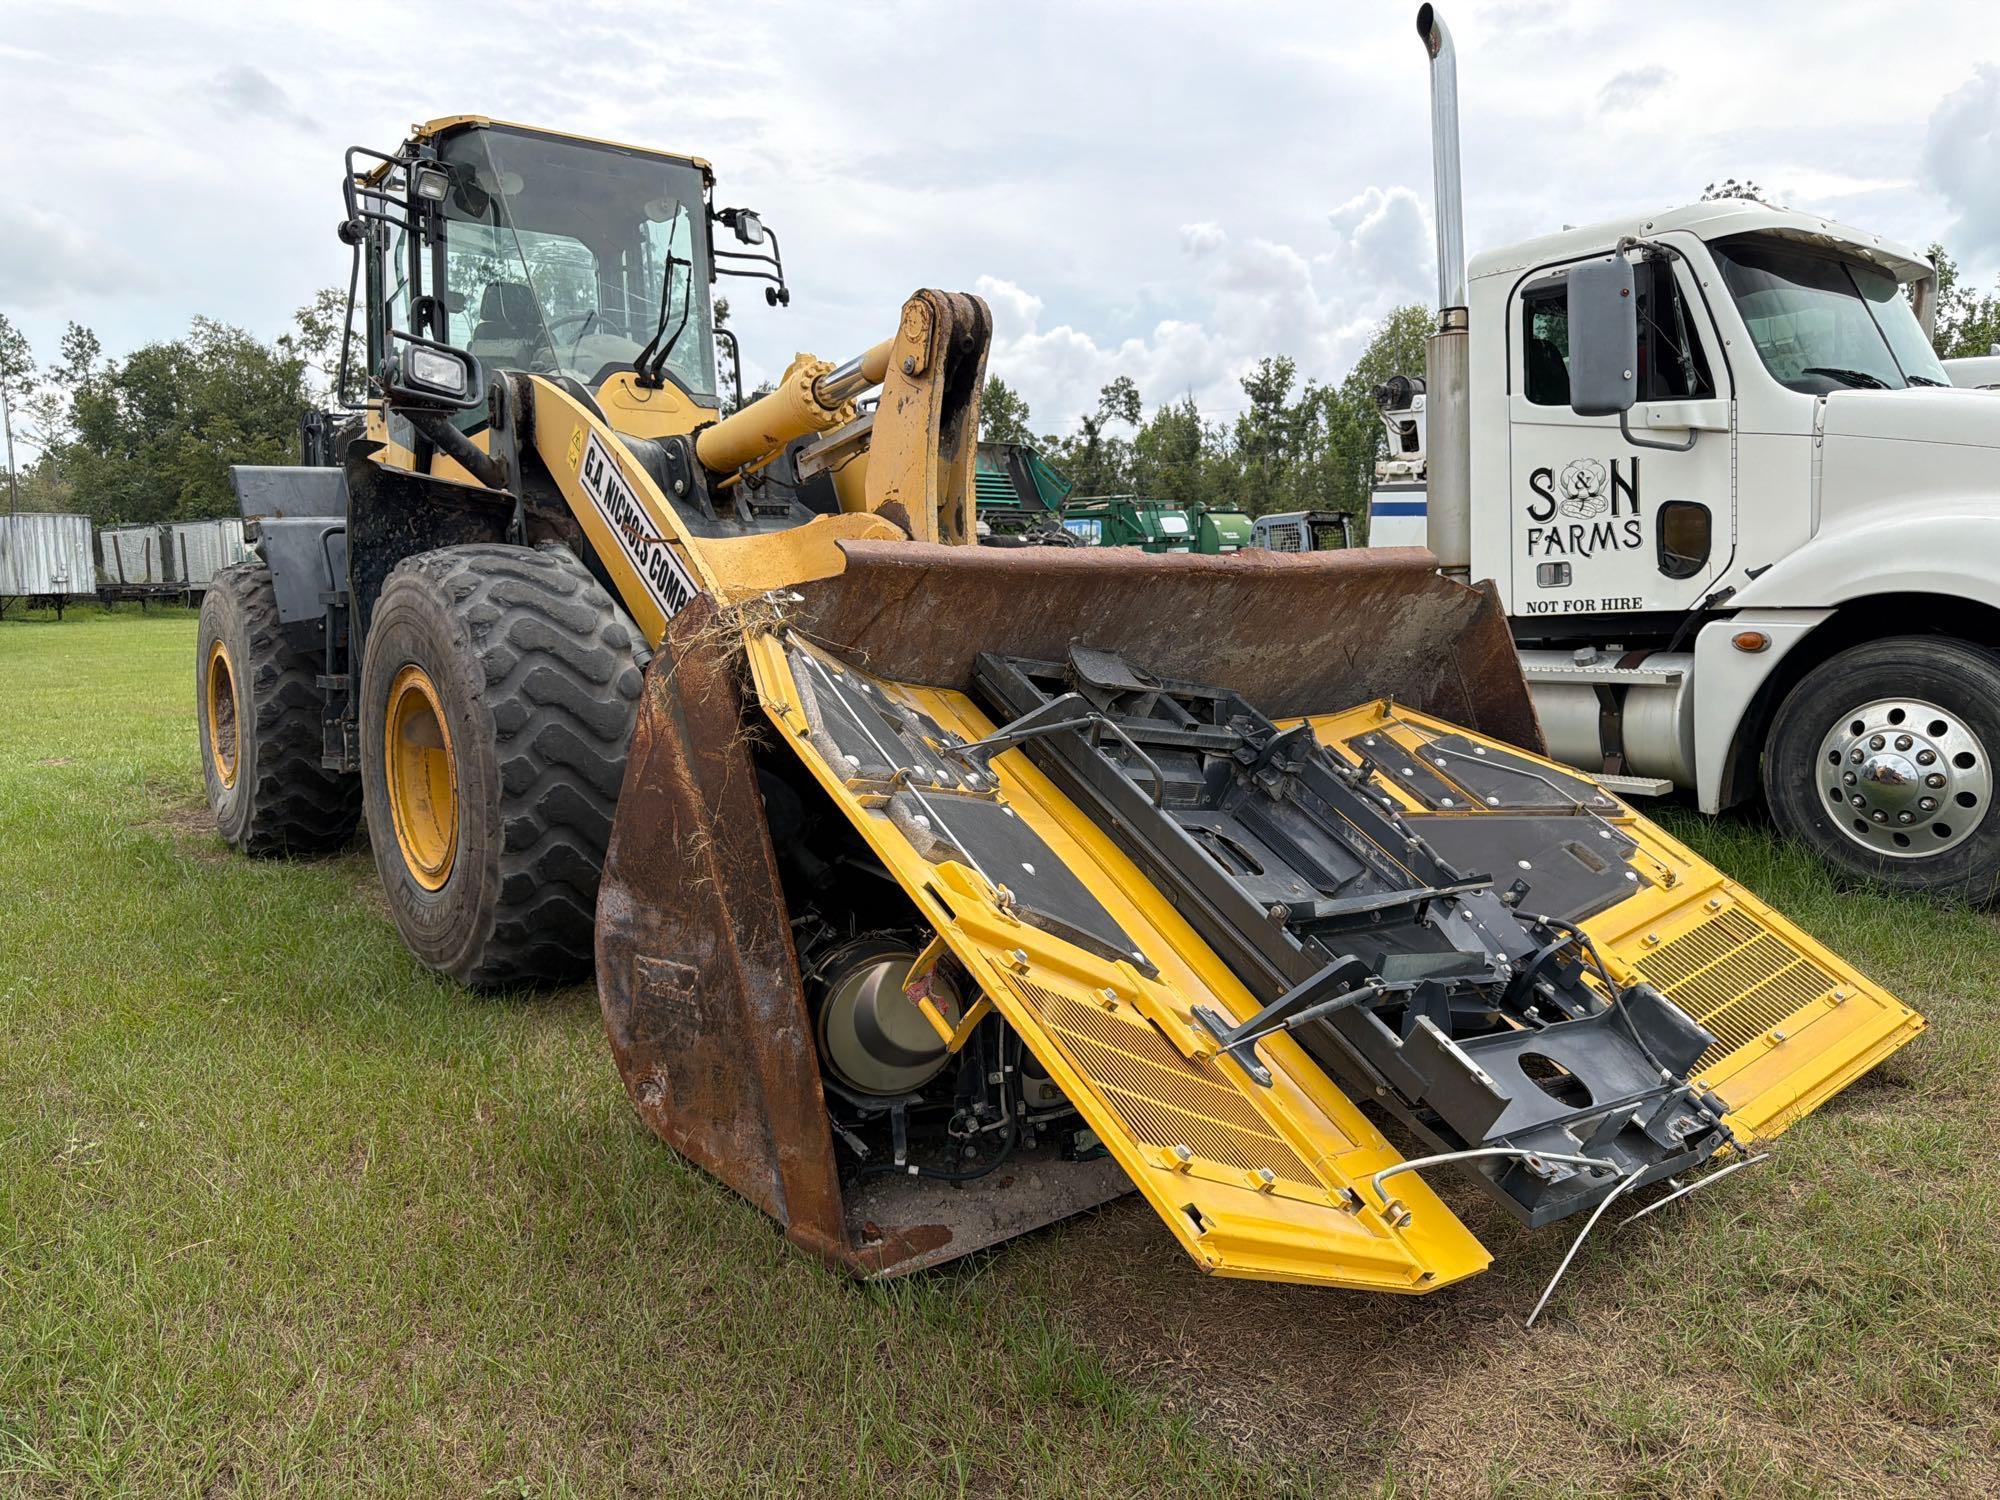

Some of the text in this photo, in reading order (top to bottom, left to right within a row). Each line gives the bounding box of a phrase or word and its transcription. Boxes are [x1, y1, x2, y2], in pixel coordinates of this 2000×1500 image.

[584, 446, 604, 497] G.A.
[603, 475, 651, 567] NICHOLS
[1527, 520, 1643, 559] FARMS
[1526, 597, 1643, 614] NOT FOR HIRE
